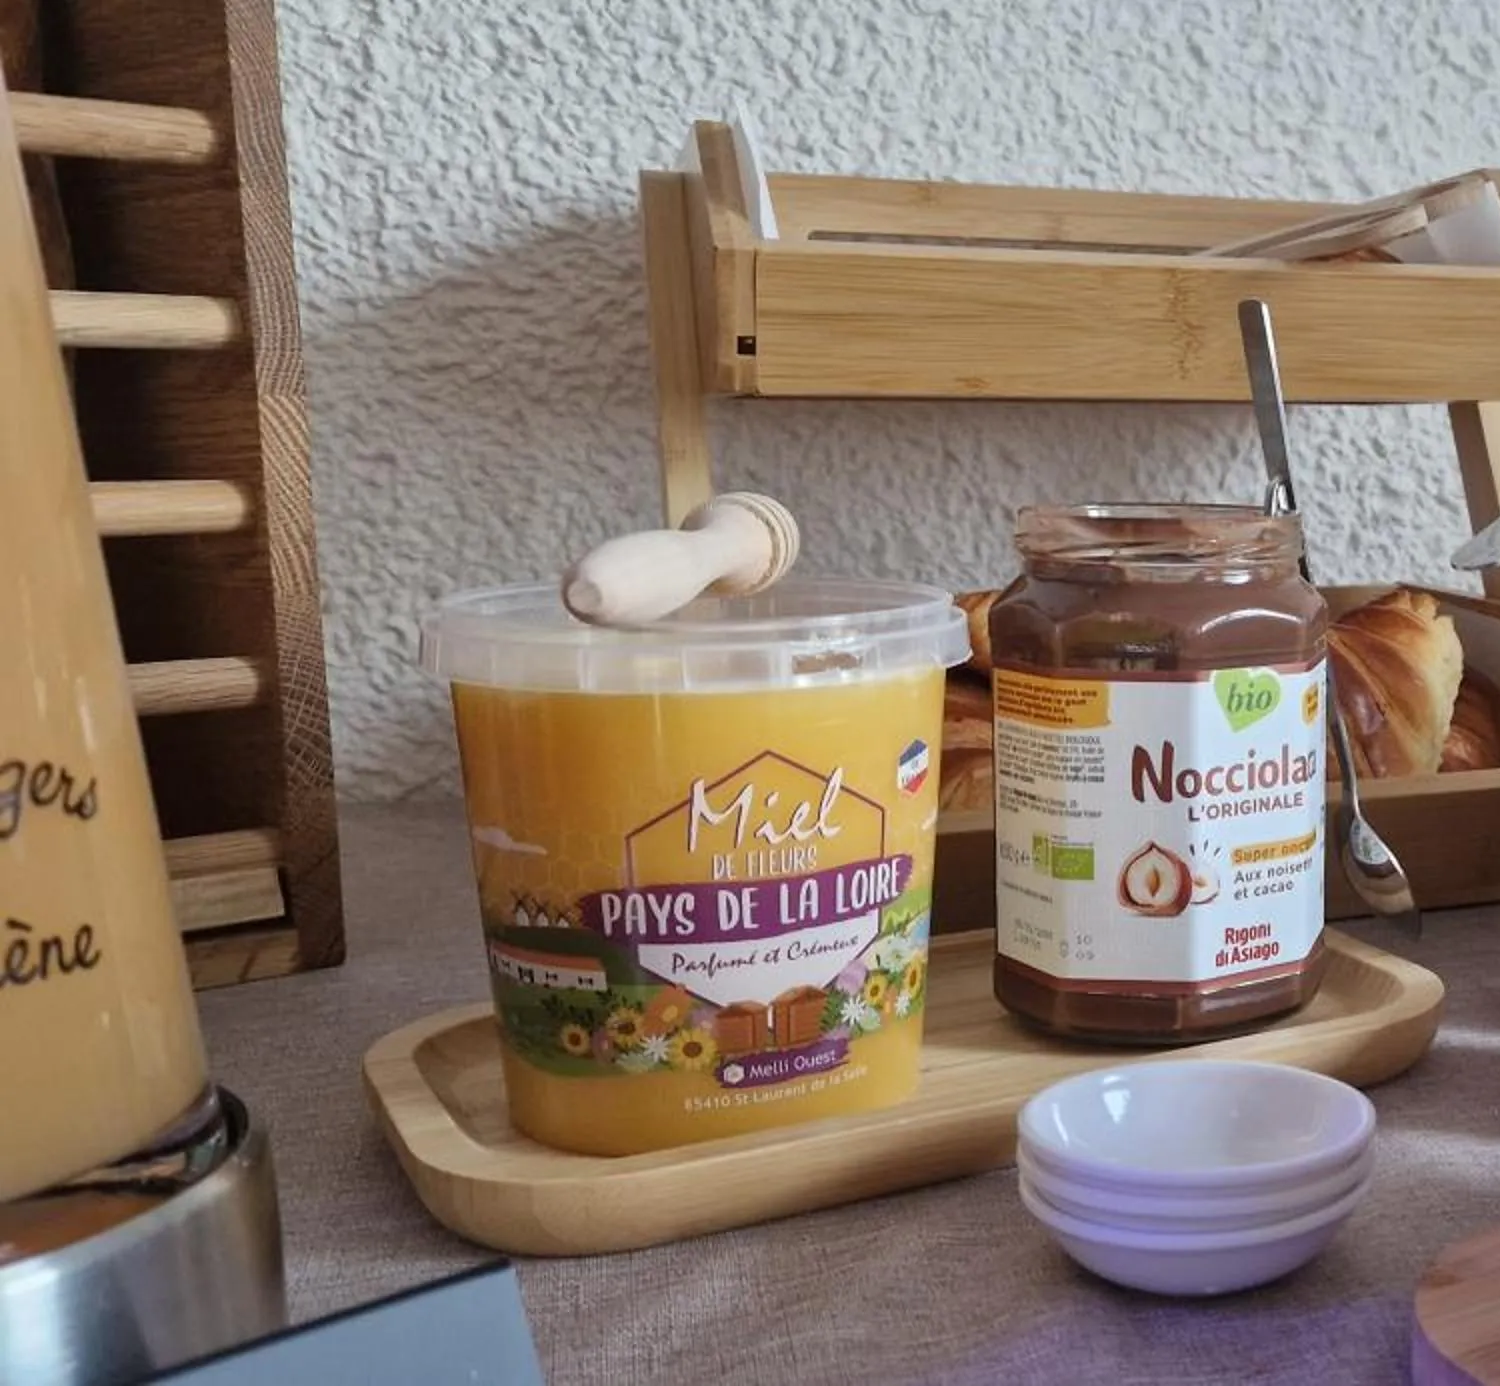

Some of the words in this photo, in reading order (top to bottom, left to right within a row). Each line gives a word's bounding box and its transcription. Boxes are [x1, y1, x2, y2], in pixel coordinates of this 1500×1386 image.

[1227, 682, 1273, 713] bio
[687, 767, 844, 854] Miel
[1187, 791, 1305, 822] L'ORIGINALE
[711, 854, 737, 881] DE
[746, 845, 818, 877] FLEURS
[1233, 869, 1263, 885] Aux
[601, 892, 695, 938] PAYS
[717, 887, 760, 931] DE
[779, 878, 820, 925] LA
[835, 857, 902, 914] LOIRE
[1233, 887, 1249, 901] et
[1253, 879, 1295, 897] cacao
[1224, 922, 1272, 947] Rigoni
[671, 949, 756, 976] Parfumé
[762, 947, 780, 963] et
[1215, 949, 1230, 967] di
[1231, 941, 1280, 965] Asiago
[750, 1059, 790, 1080] Melli
[793, 1049, 837, 1072] Ouest
